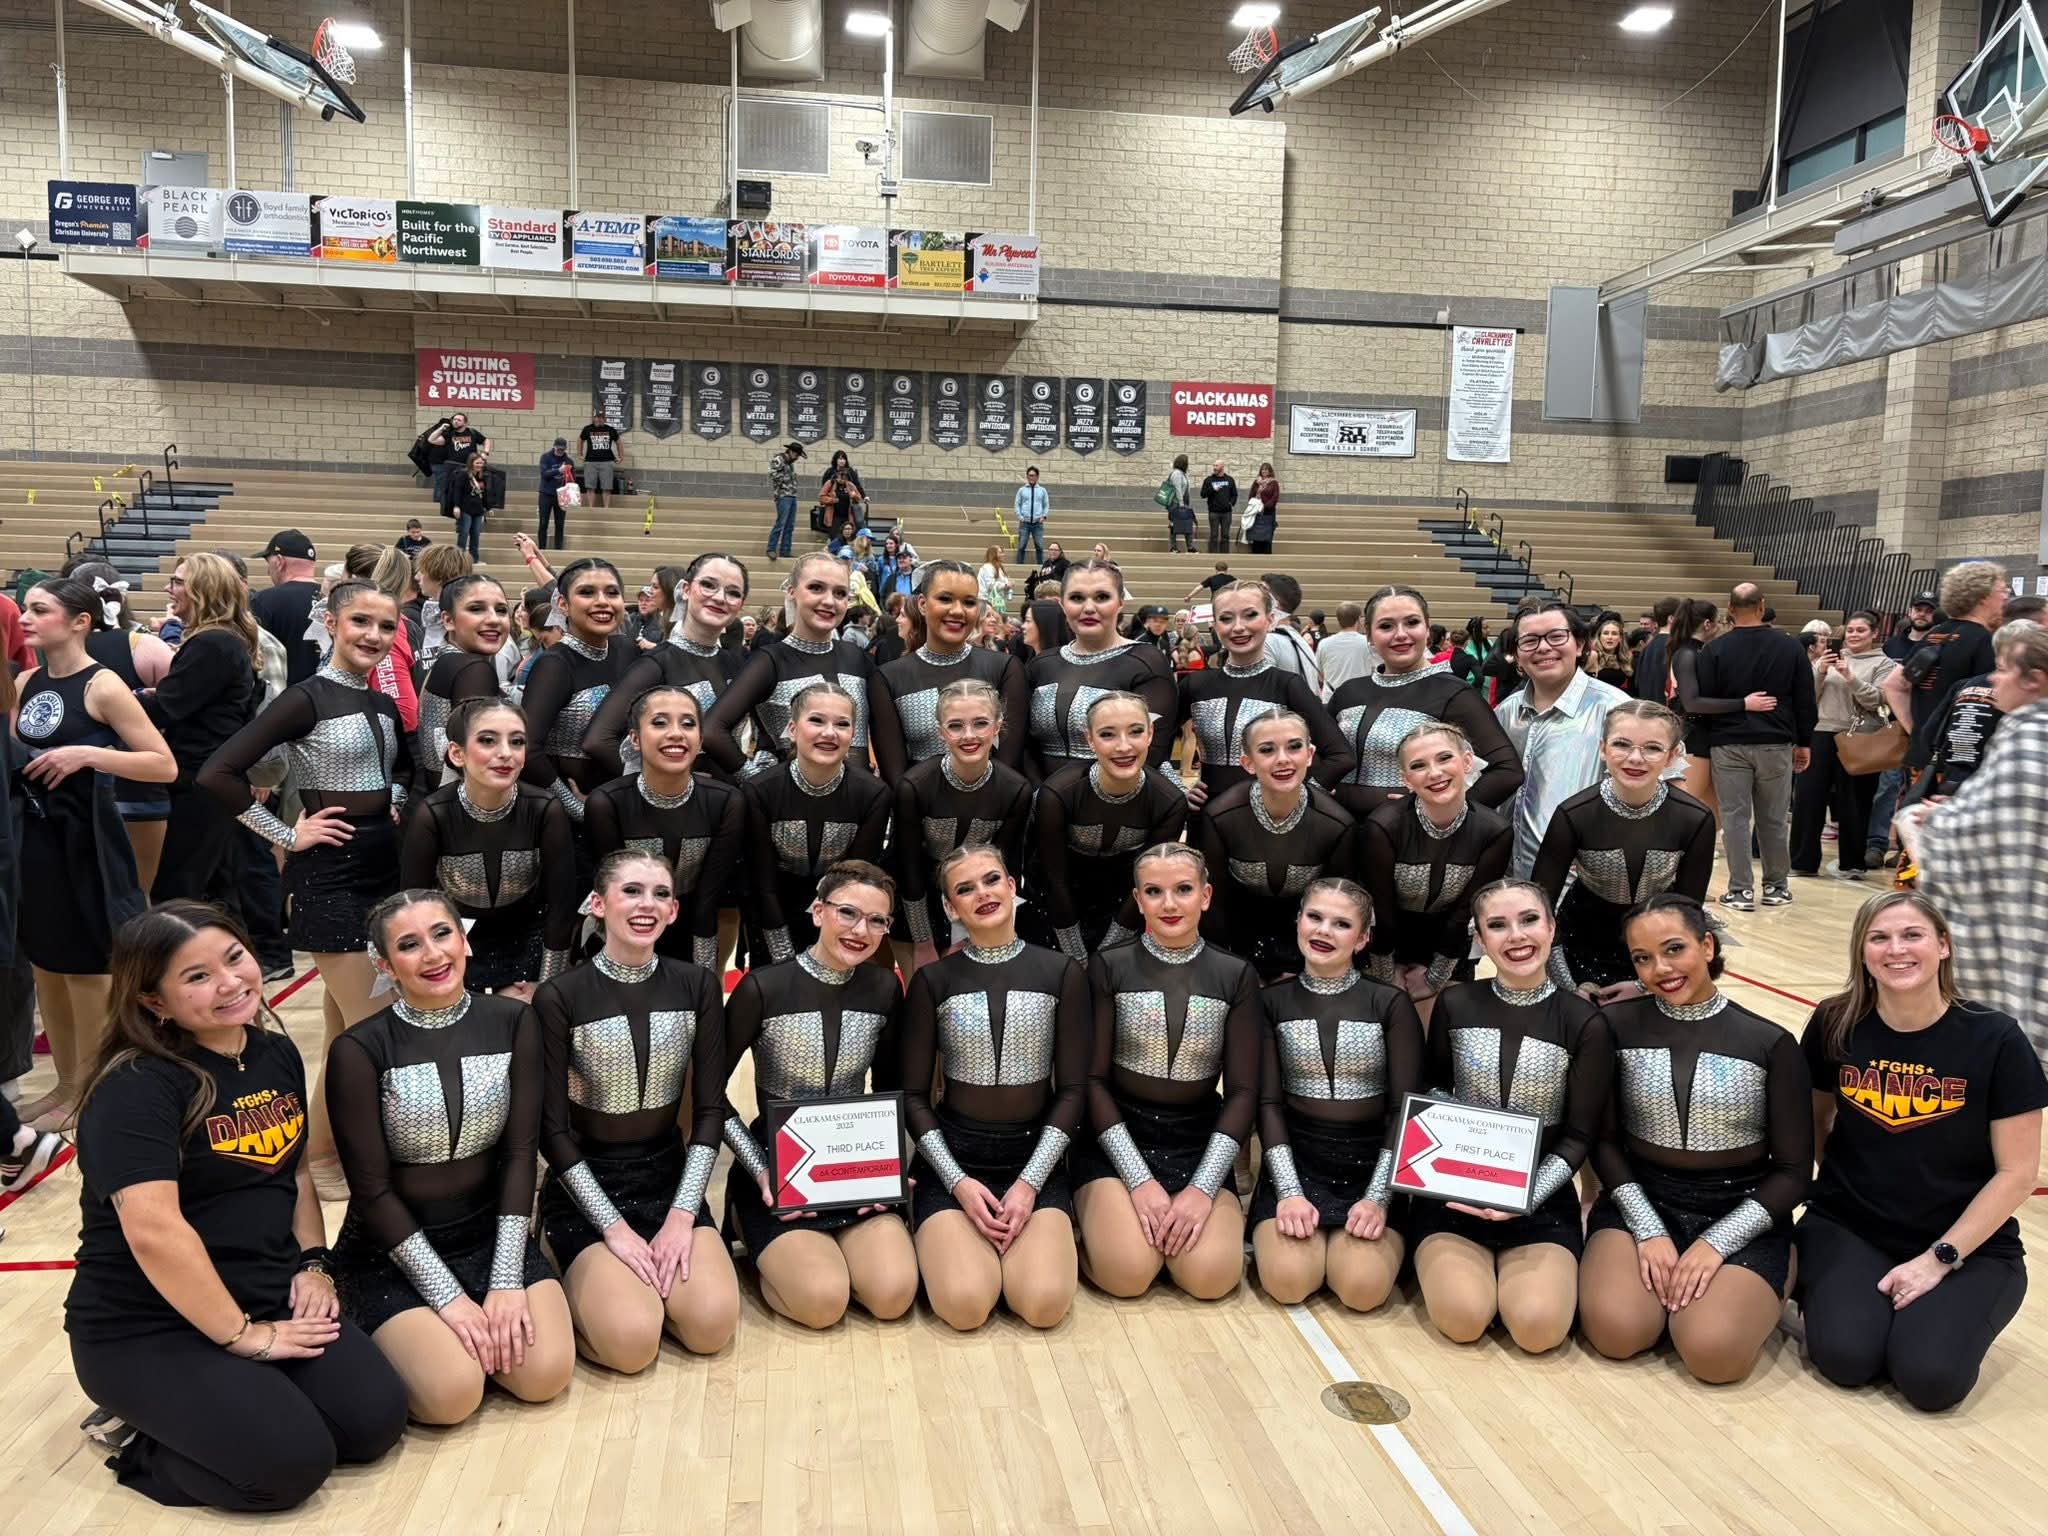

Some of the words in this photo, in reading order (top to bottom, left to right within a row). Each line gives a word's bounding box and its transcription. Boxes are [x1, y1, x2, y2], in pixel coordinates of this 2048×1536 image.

[76, 194, 111, 204] GEORGE
[114, 196, 131, 206] FOX
[163, 189, 207, 201] BLACK
[163, 202, 208, 214] PEARL
[285, 203, 308, 214] family
[402, 220, 431, 231] Built
[434, 221, 452, 232] for
[455, 222, 475, 233] the
[488, 218, 556, 233] Standard
[577, 219, 640, 234] A-TEMP
[55, 228, 80, 236] Christian
[81, 230, 109, 238] University
[402, 232, 444, 244] Pacific
[512, 234, 555, 242] APPLIANCE
[842, 240, 879, 248] TOYOTA
[402, 244, 467, 257] Northwest
[741, 247, 801, 260] STANFORDS
[998, 244, 1038, 262] Plywood
[919, 260, 963, 268] BARTLETT
[828, 273, 875, 283] TOYOTA.COM
[1480, 331, 1514, 340] CLACKAMAS
[1471, 337, 1513, 346] CAVALETTES
[440, 355, 511, 371] VISITING
[432, 370, 518, 387] STUDENTS
[706, 371, 716, 381] G
[755, 373, 765, 384] G
[803, 375, 813, 386] G
[850, 377, 860, 388] G
[898, 380, 907, 390] G
[944, 382, 954, 392] G
[428, 385, 440, 398] &
[447, 386, 522, 402] PARENTS
[991, 384, 1000, 394] G
[1037, 386, 1046, 396] G
[1080, 388, 1089, 398] G
[1123, 390, 1132, 399] G
[1174, 390, 1269, 408] CLACKAMAS
[705, 402, 717, 410] JEN
[701, 410, 721, 418] REESE
[746, 412, 775, 420] WETZLER
[889, 411, 915, 419] ELLIOTT
[1186, 411, 1256, 427] PARENTS
[1032, 416, 1051, 424] JAZZY
[1117, 419, 1136, 427] JAZZY
[979, 422, 1011, 430] DAVIDSON
[1069, 425, 1100, 433] DAVIDSON
[1111, 426, 1142, 434] DAVIDSON
[22, 694, 60, 718] WILSONVILLE
[1878, 1059, 1925, 1075] FGHS
[1839, 1064, 1968, 1118] DANCE
[236, 1089, 273, 1110] FGHS
[793, 1113, 841, 1124] CLACKAMAS
[841, 1110, 896, 1121] COMPETITION
[206, 1091, 304, 1155] DANCE
[835, 1121, 854, 1130] 2025
[1427, 1111, 1475, 1126] CLACKAMAS
[1476, 1119, 1534, 1136] COMPETITION
[1468, 1126, 1488, 1135] 2025
[827, 1144, 853, 1154] THIRD
[855, 1141, 885, 1152] PLACE
[1455, 1143, 1481, 1156] FIRST
[1483, 1148, 1516, 1162] PLACE
[830, 1163, 894, 1176] CONTEMPORARY
[1477, 1169, 1497, 1178] POM
